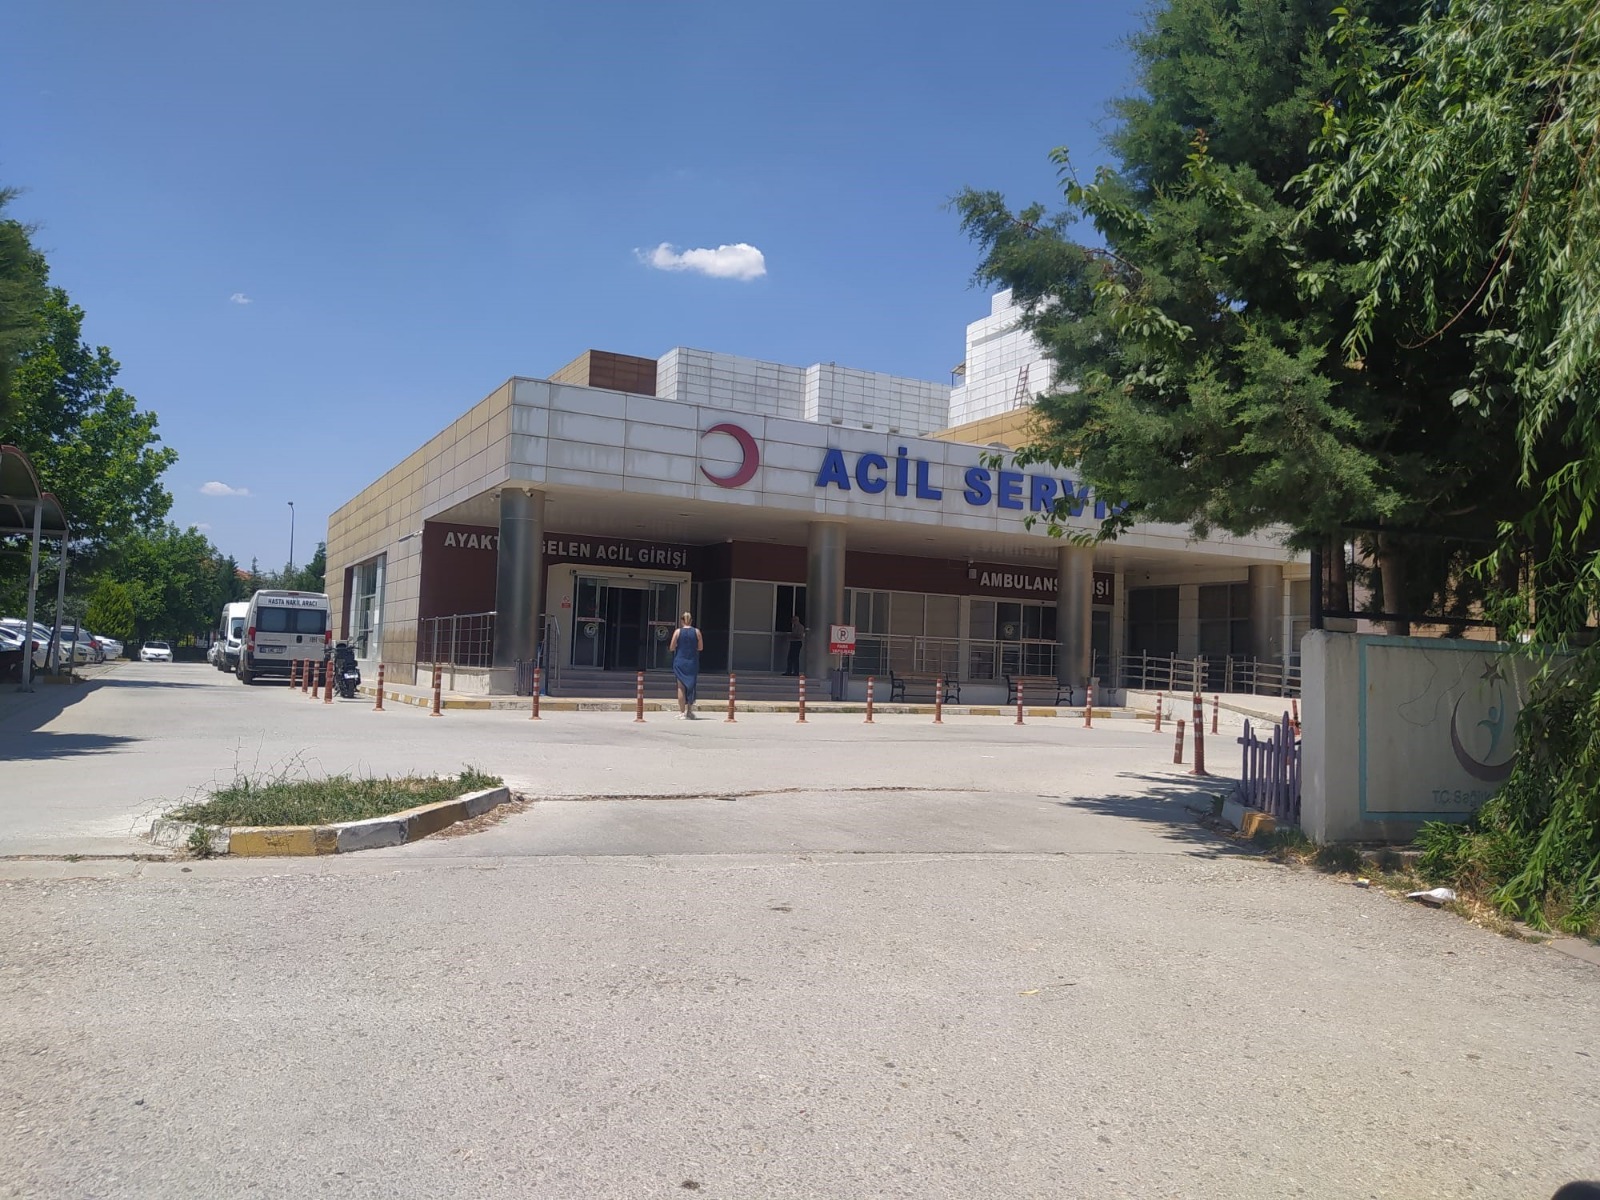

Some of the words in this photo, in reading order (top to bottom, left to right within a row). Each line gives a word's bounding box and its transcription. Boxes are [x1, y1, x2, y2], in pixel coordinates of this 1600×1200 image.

[814, 446, 943, 501] ACİL
[596, 543, 633, 562] ACİL
[638, 546, 687, 568] GİRİŞİ
